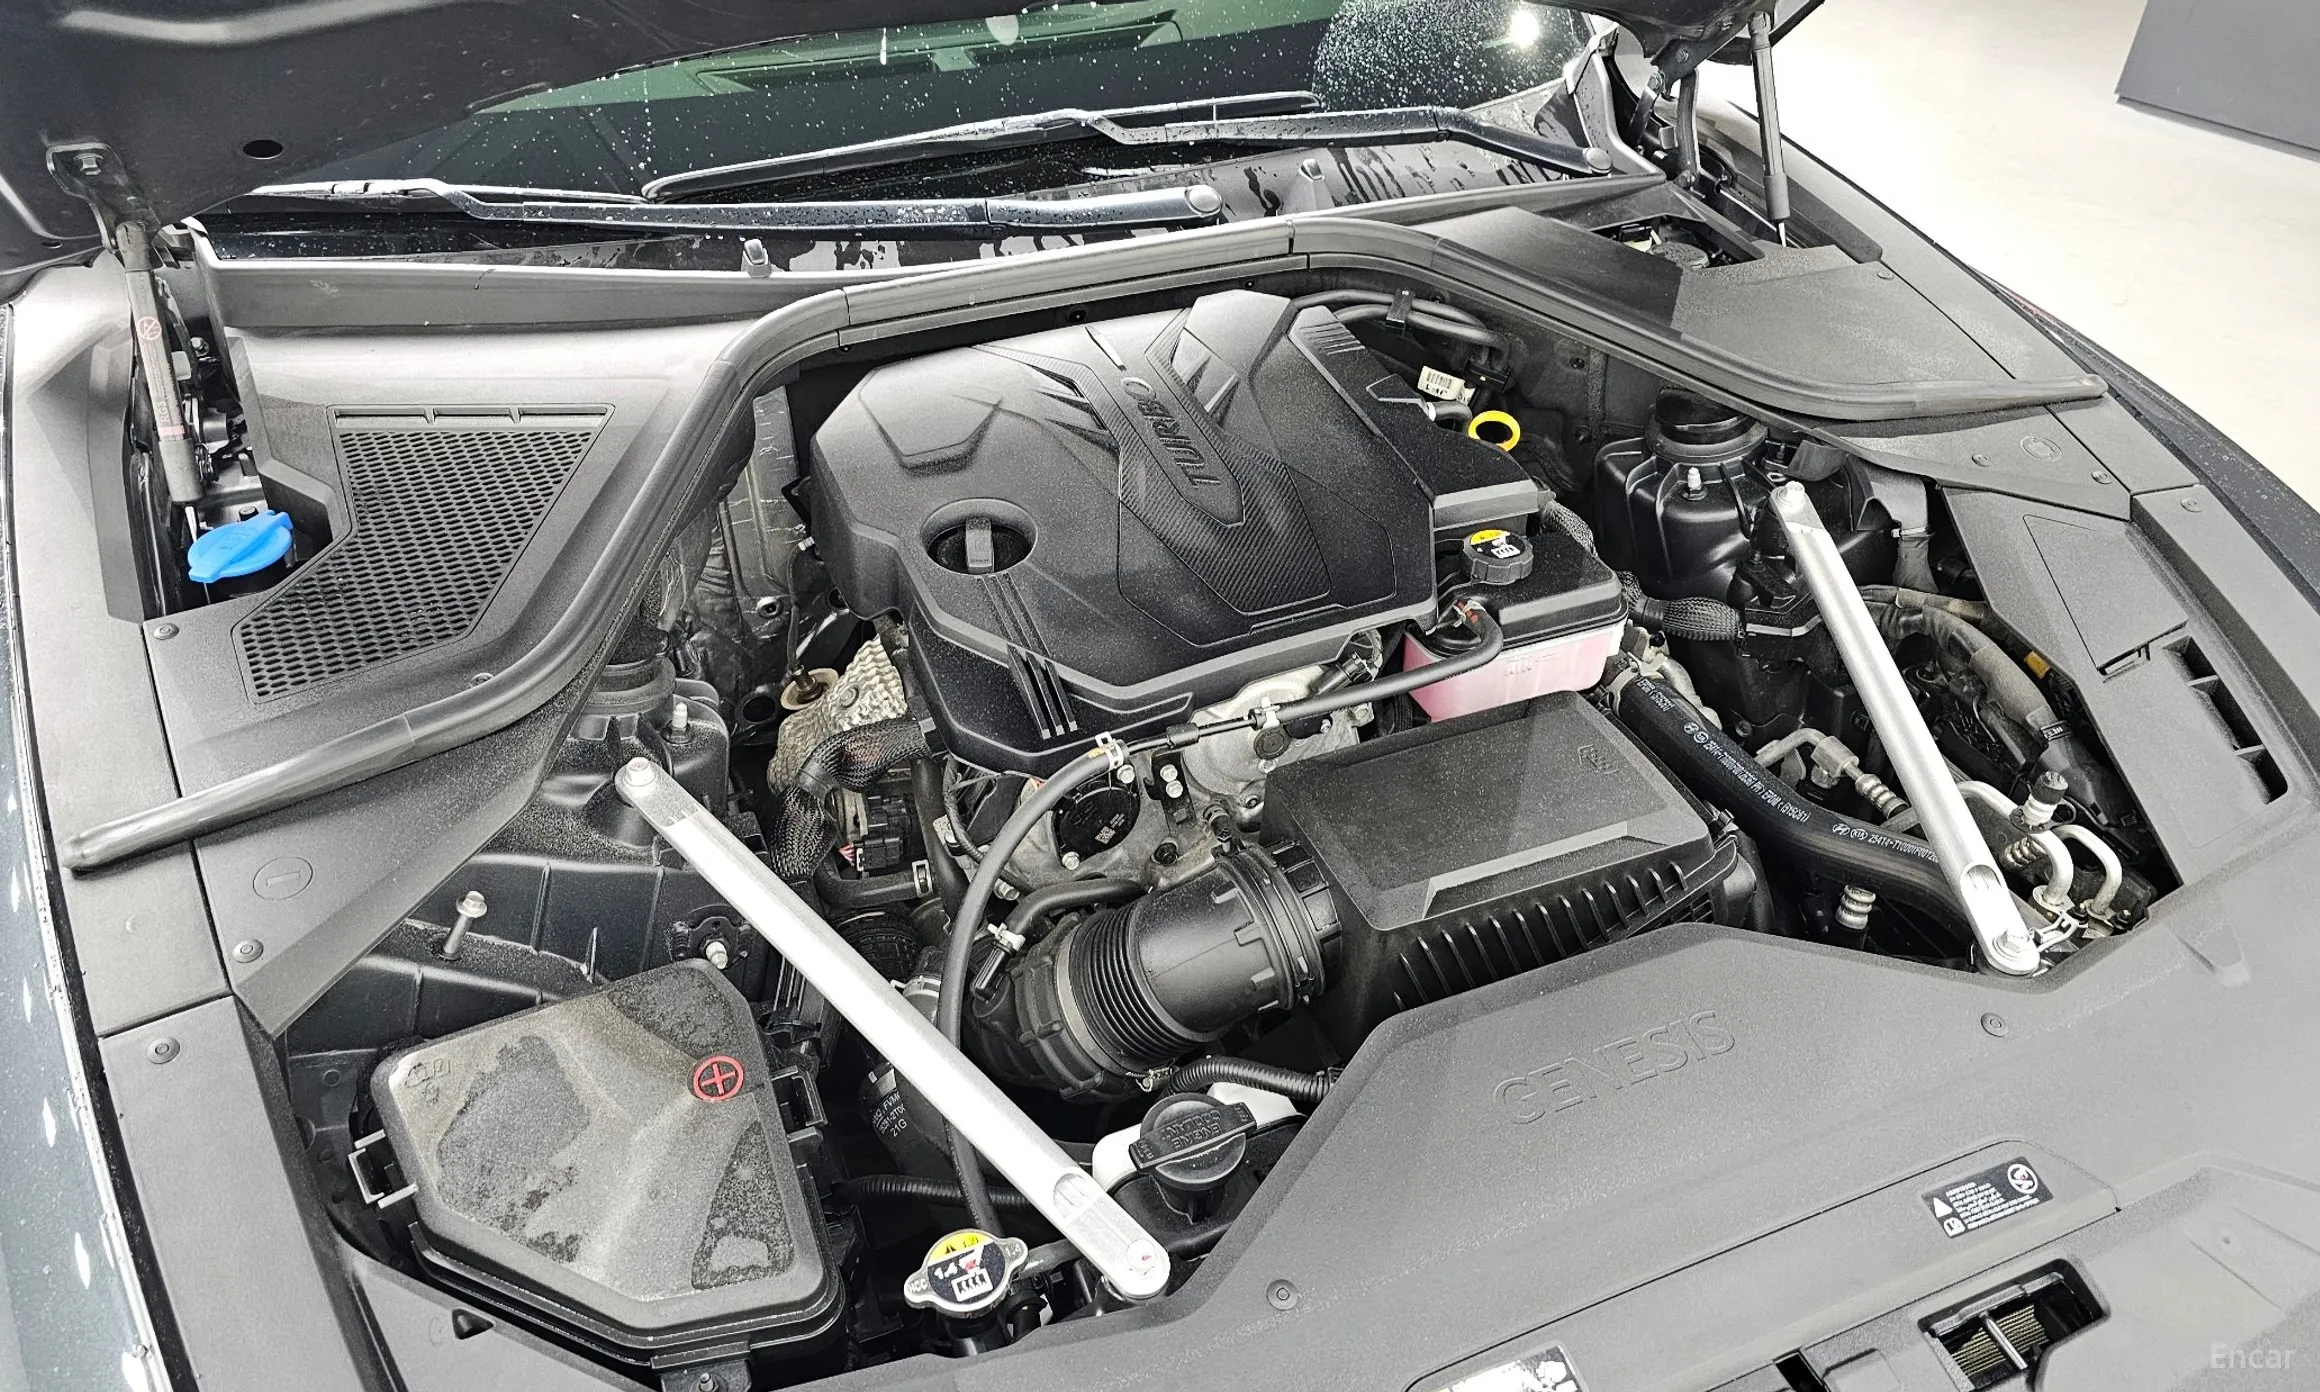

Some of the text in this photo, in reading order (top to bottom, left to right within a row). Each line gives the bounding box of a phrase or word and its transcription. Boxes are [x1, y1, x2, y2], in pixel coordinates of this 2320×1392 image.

[1121, 377, 1220, 487] TURBO
[1493, 1010, 1735, 1125] GENESIS
[890, 1118, 907, 1137] 21G
[1161, 1109, 1221, 1141] COOLANT
[1171, 1122, 1222, 1150] ENGINE
